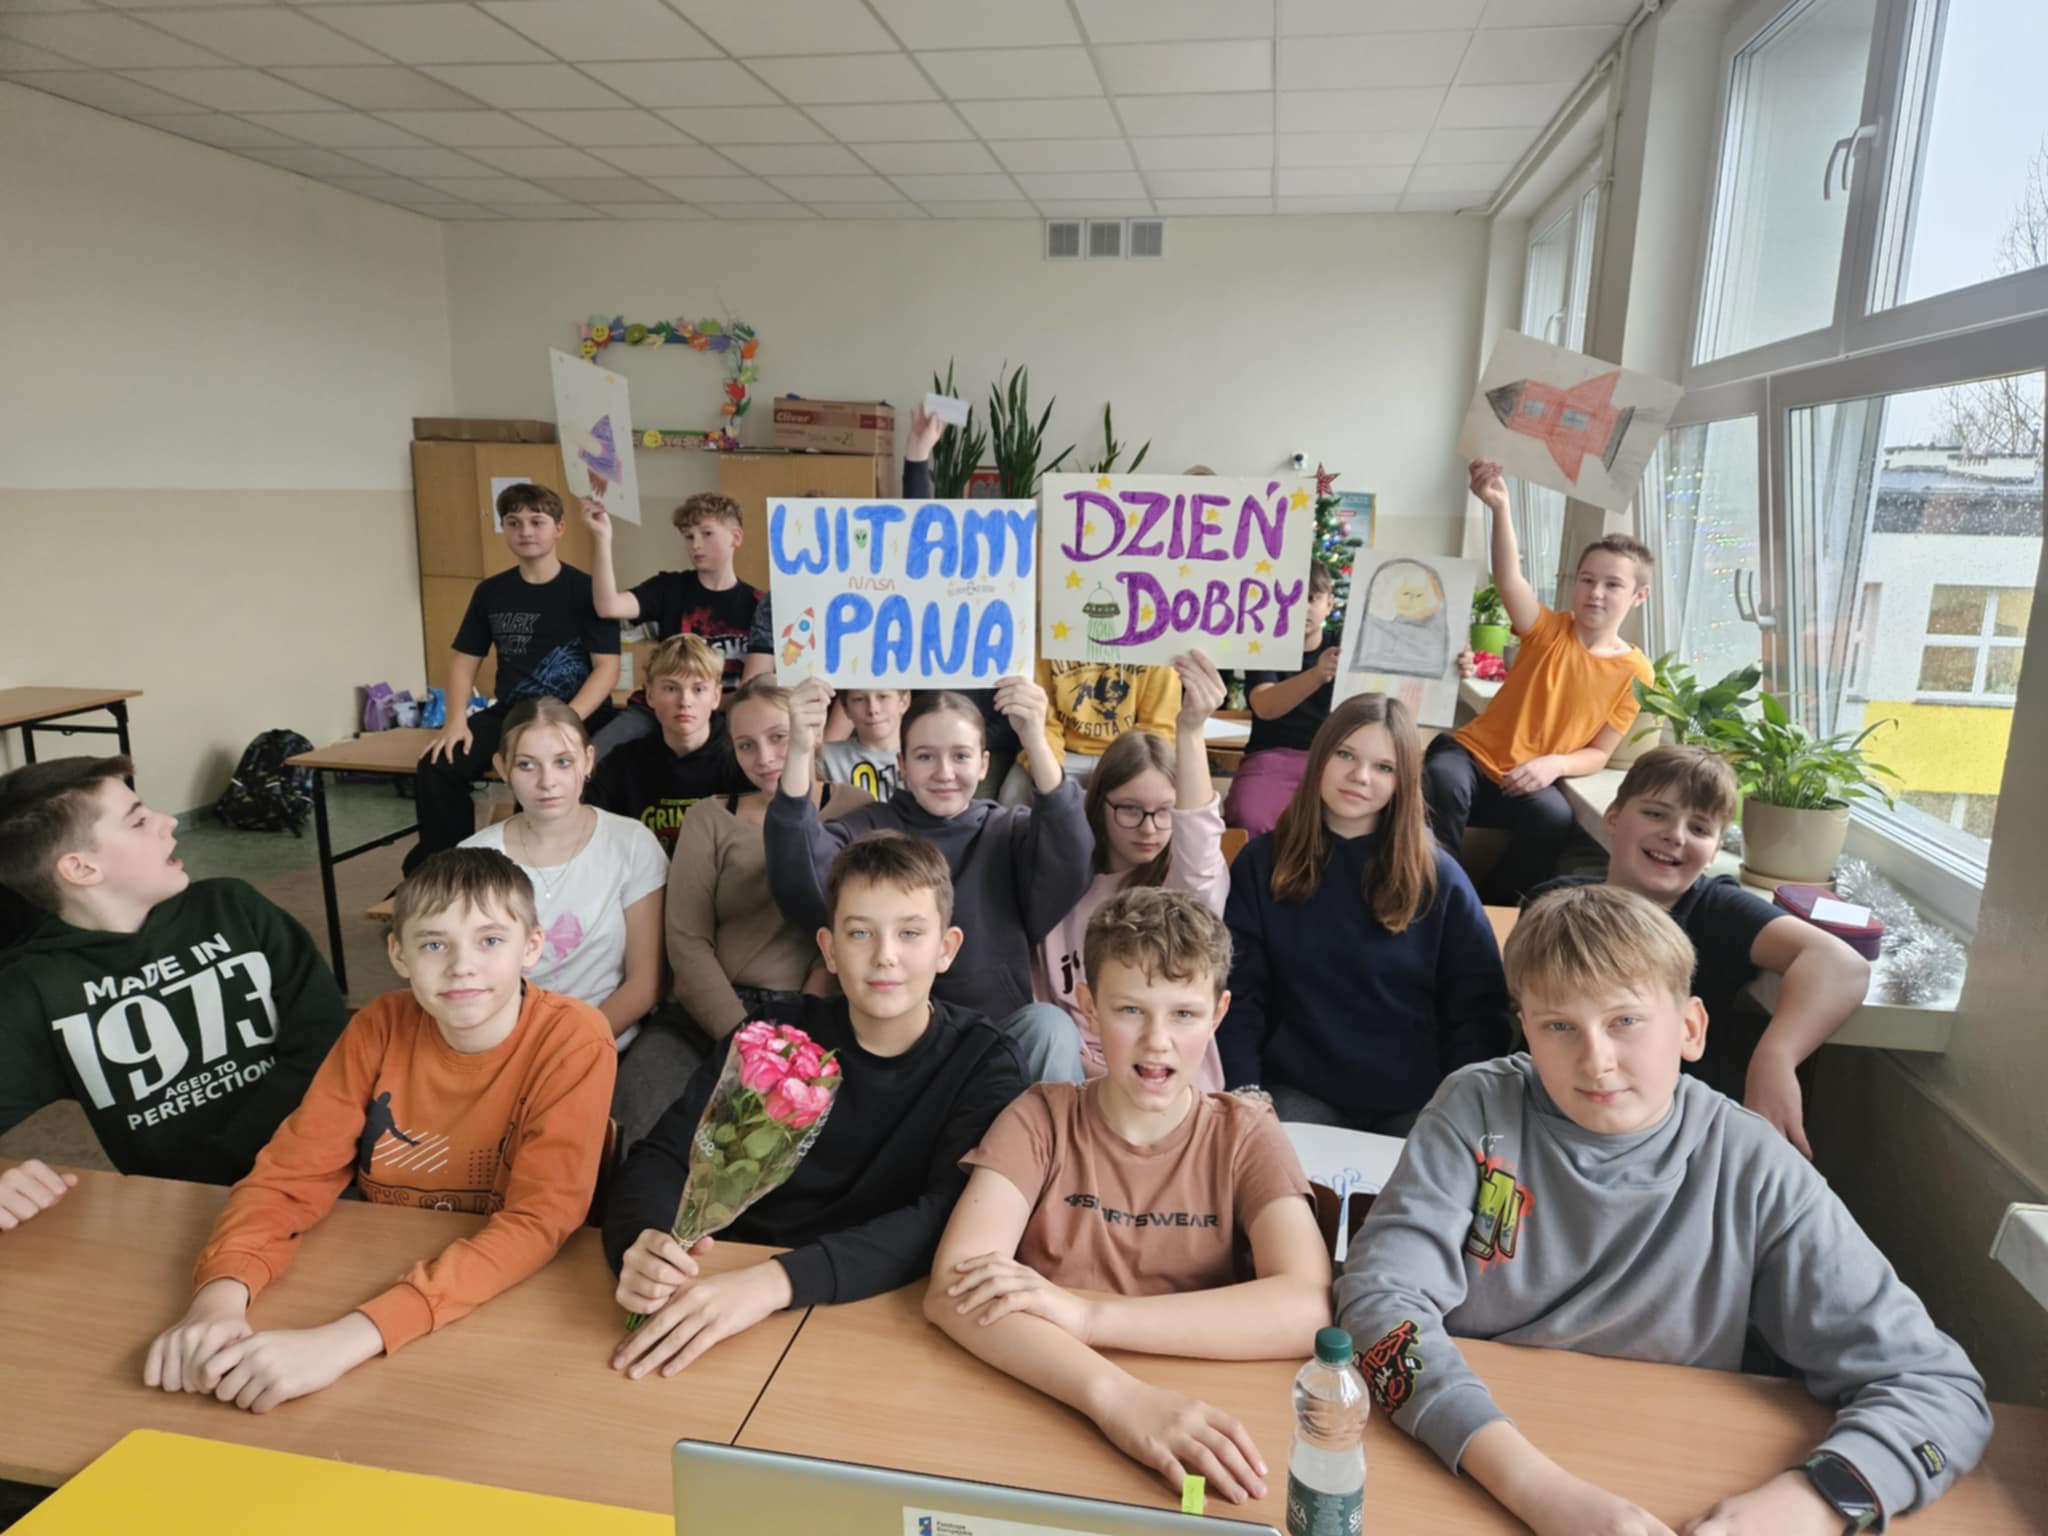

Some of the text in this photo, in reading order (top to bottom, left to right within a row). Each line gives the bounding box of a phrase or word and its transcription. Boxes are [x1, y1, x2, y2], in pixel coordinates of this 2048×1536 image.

[769, 503, 1037, 579] WITAMY
[1061, 481, 1289, 562] DZIEŃ
[848, 575, 896, 592] NASA
[1088, 570, 1303, 647] DOBRY
[824, 592, 1014, 678] PANA
[83, 932, 232, 1006] MADE IN
[52, 951, 280, 1110] 1973
[127, 1055, 277, 1131] PERFECTION
[165, 1060, 238, 1099] AGED TO
